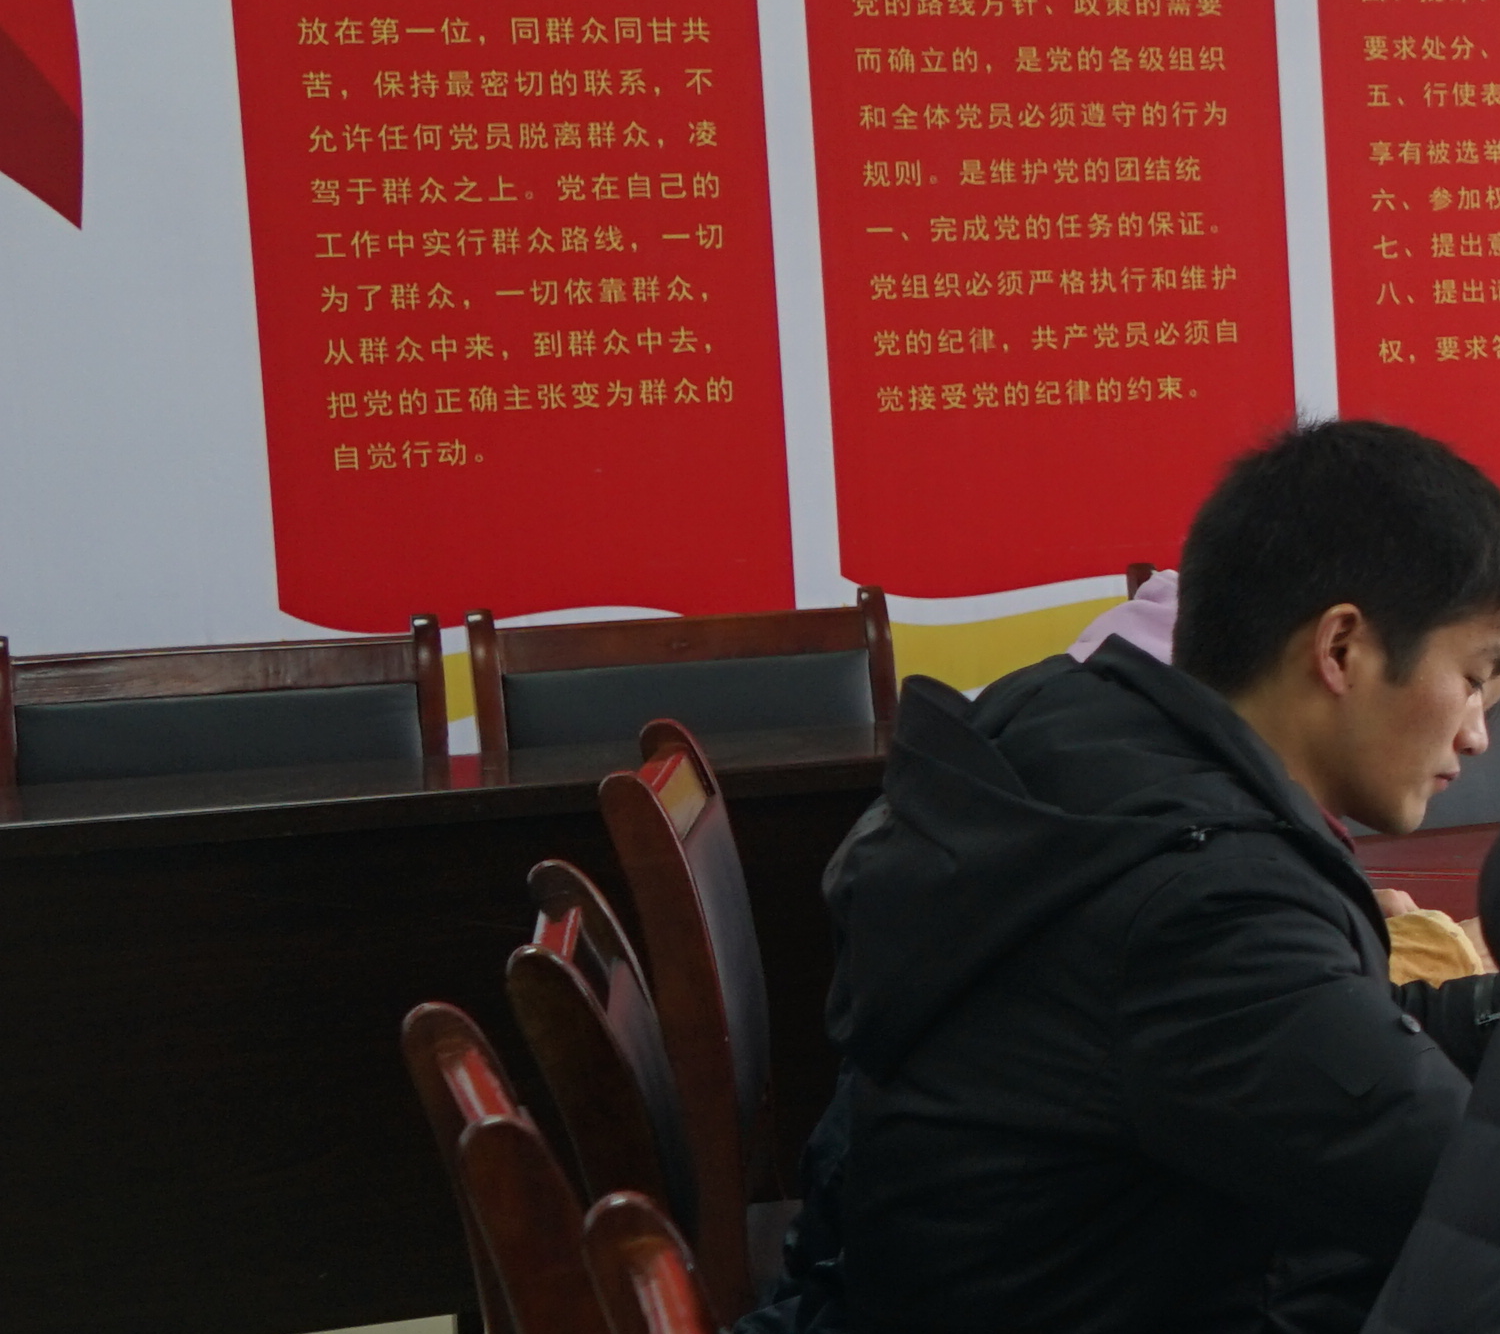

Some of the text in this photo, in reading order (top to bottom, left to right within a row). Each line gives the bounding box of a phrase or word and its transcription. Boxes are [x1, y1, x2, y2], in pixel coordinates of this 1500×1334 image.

[299, 18, 710, 45] 放在第一位，同群众同甘共
[303, 70, 713, 98] 苦，保持最密切的联系，不
[309, 122, 718, 153] 允许任何党员脱离群众，凌
[312, 174, 720, 206] 驾于群众之上。党在自己的
[317, 226, 723, 258] 工作中实行群众路线，一切
[322, 277, 712, 313] 为了群众，一切依靠群众，
[325, 329, 714, 364] 从群众中来，到群众中去，
[329, 379, 734, 419] 把党的正确主张变为群众的
[335, 442, 486, 470] 自觉行动。
